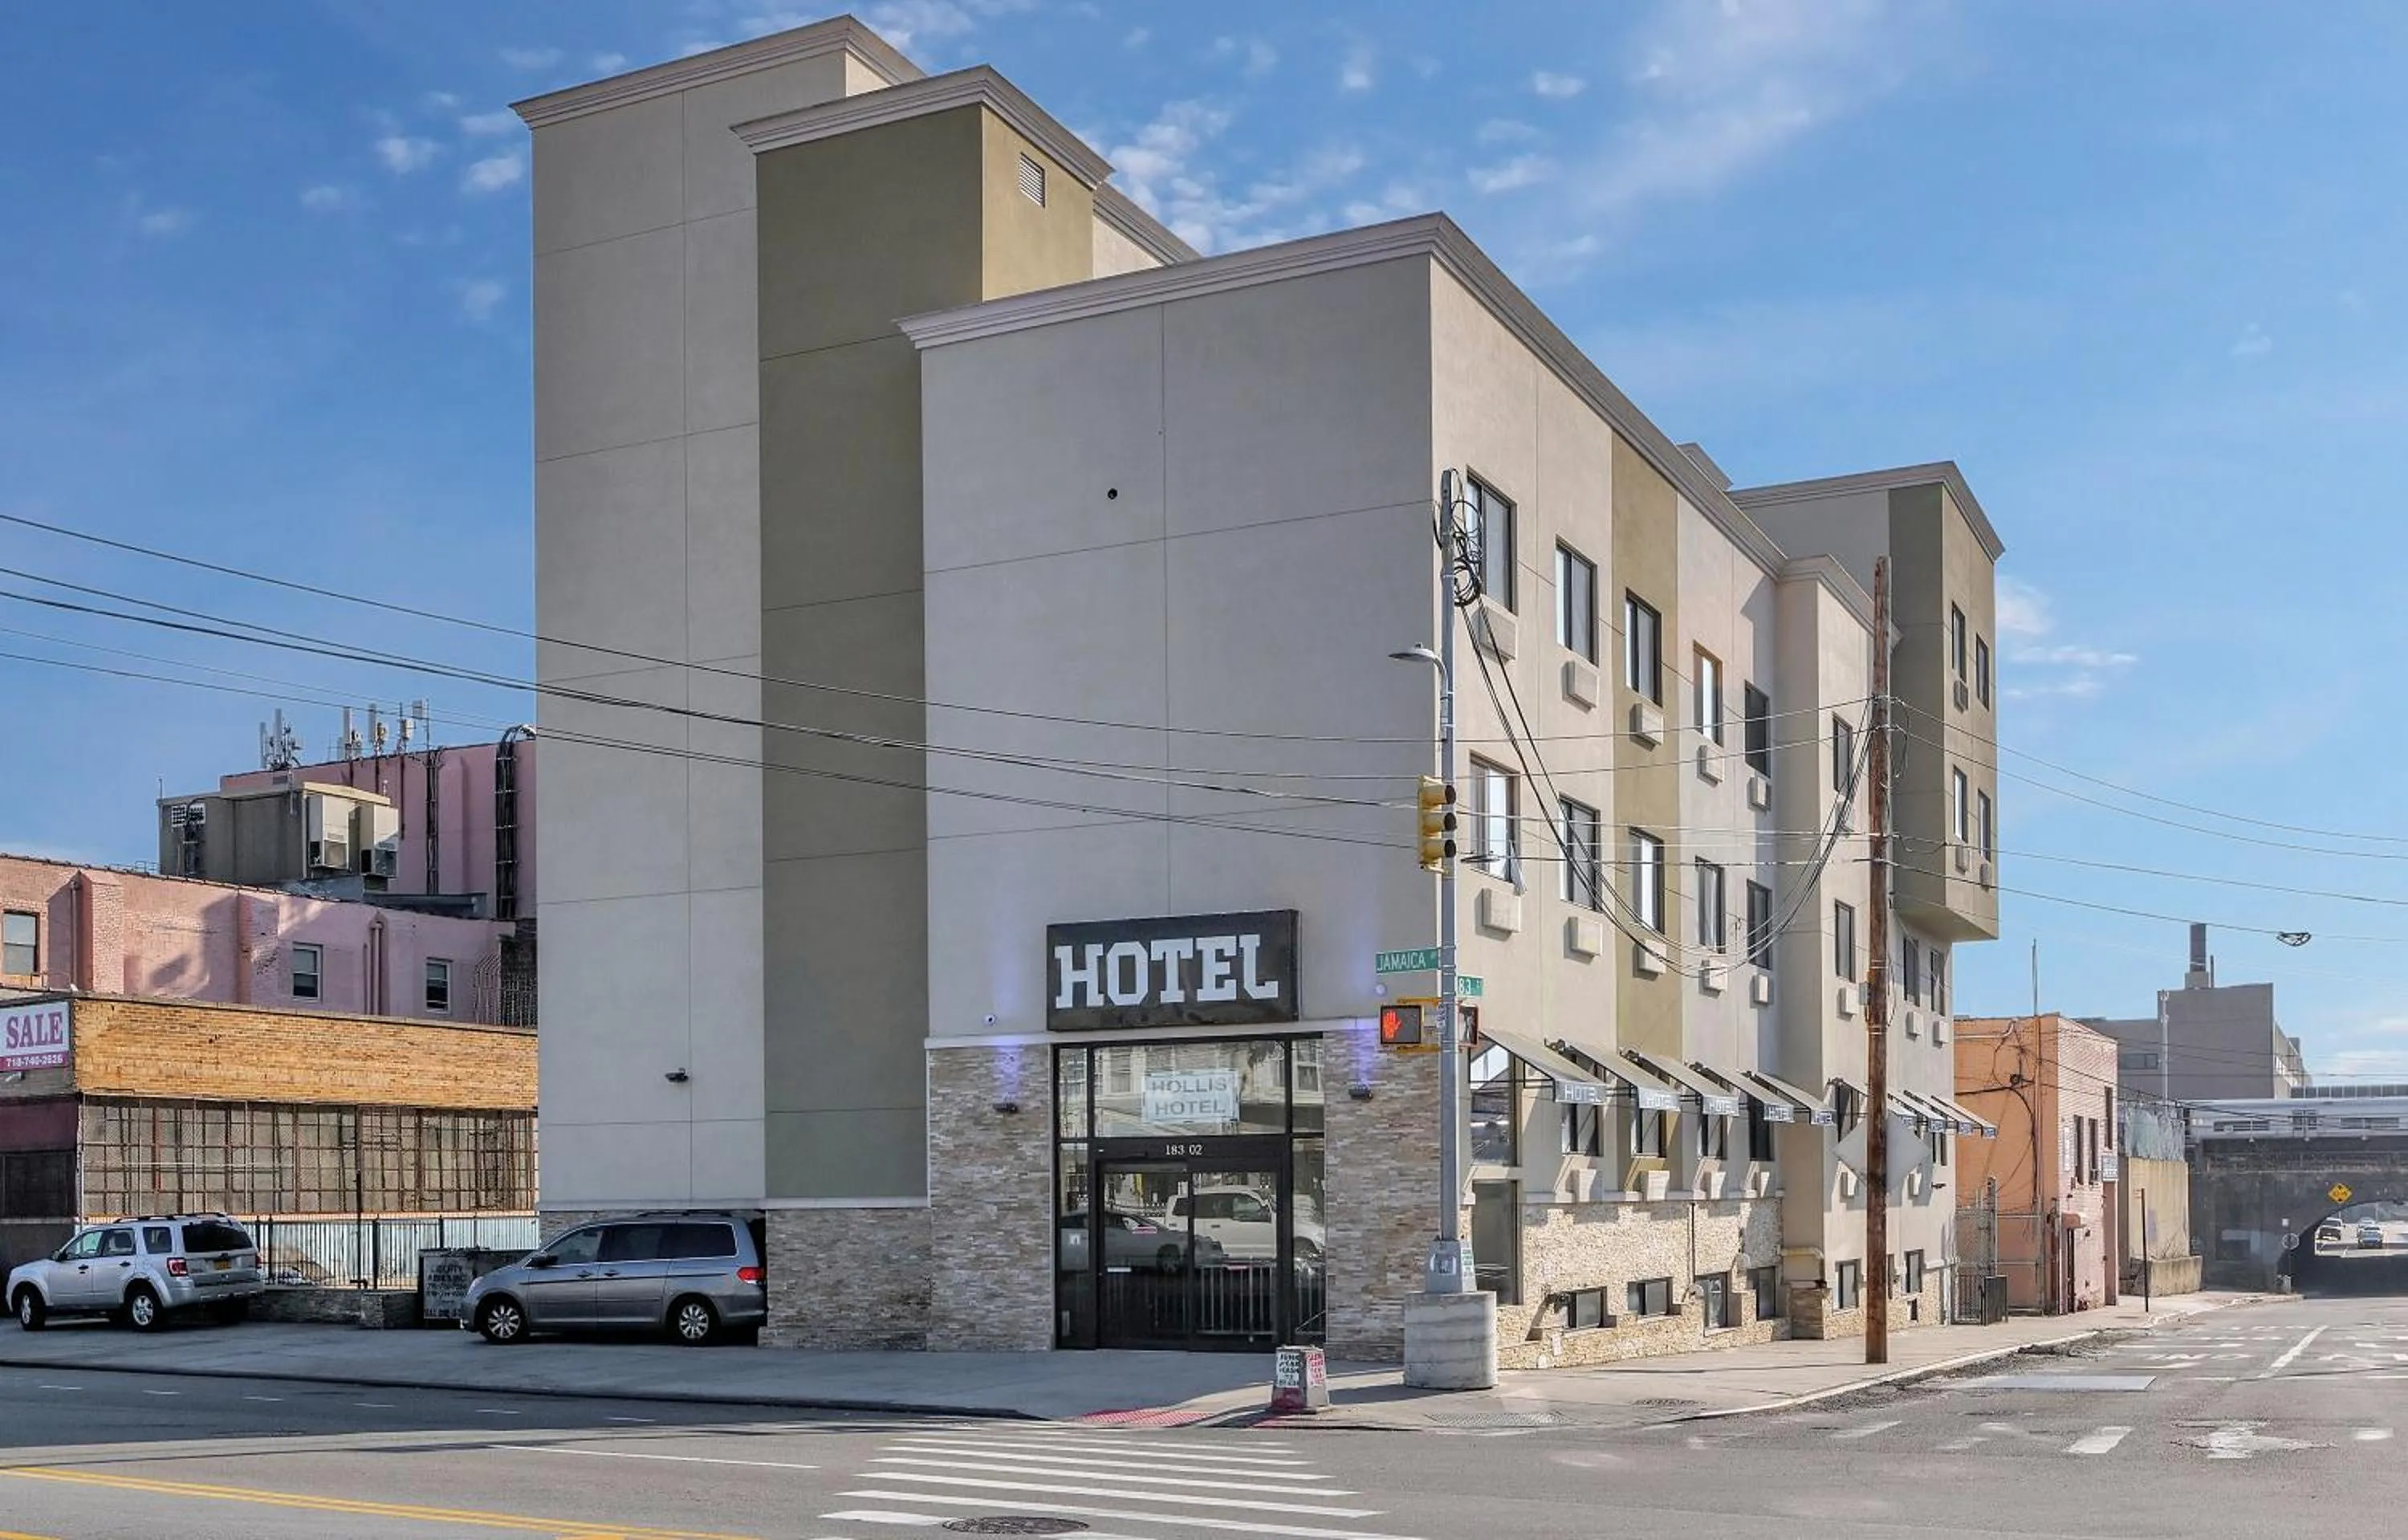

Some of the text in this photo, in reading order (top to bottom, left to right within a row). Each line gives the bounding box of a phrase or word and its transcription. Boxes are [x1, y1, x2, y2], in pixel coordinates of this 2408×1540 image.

[1377, 951, 1426, 972] JAMAICA
[1054, 933, 1279, 1009] HOTEL
[6, 1012, 63, 1049] SALE
[1152, 1078, 1227, 1093] HOLLIS
[1564, 1085, 1602, 1102] HOTEL
[1155, 1098, 1226, 1115] HOTEL
[1165, 1144, 1203, 1155] 183 02
